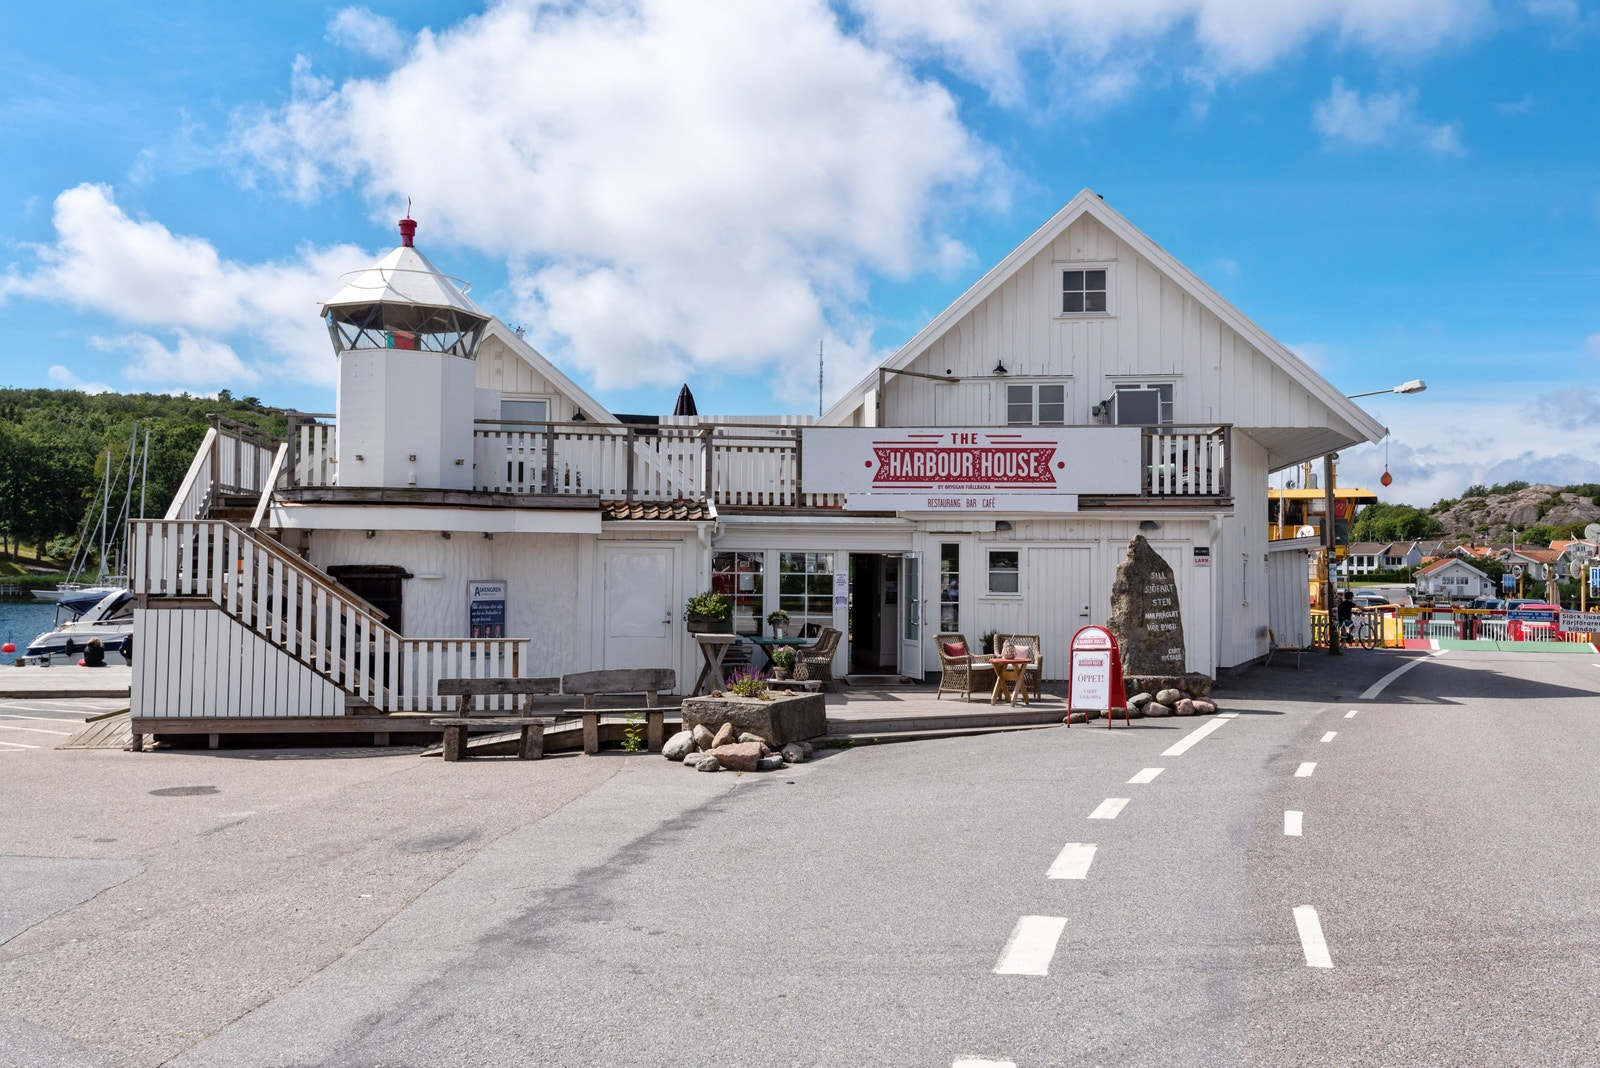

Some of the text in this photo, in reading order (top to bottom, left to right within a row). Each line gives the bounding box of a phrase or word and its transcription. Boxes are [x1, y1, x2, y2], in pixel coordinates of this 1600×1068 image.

[951, 433, 978, 444] THE
[889, 452, 1040, 477] HARBOUR HOUSE
[927, 497, 996, 508] RESTAURANG BAR CAFÉ
[1151, 572, 1167, 580] SILL
[474, 587, 501, 596] ASKENGREN
[1145, 583, 1174, 593] SJÖFART
[1152, 598, 1171, 606] STEN
[1147, 622, 1177, 631] VÅR BYGD
[1077, 673, 1104, 682] ÖPPET!
